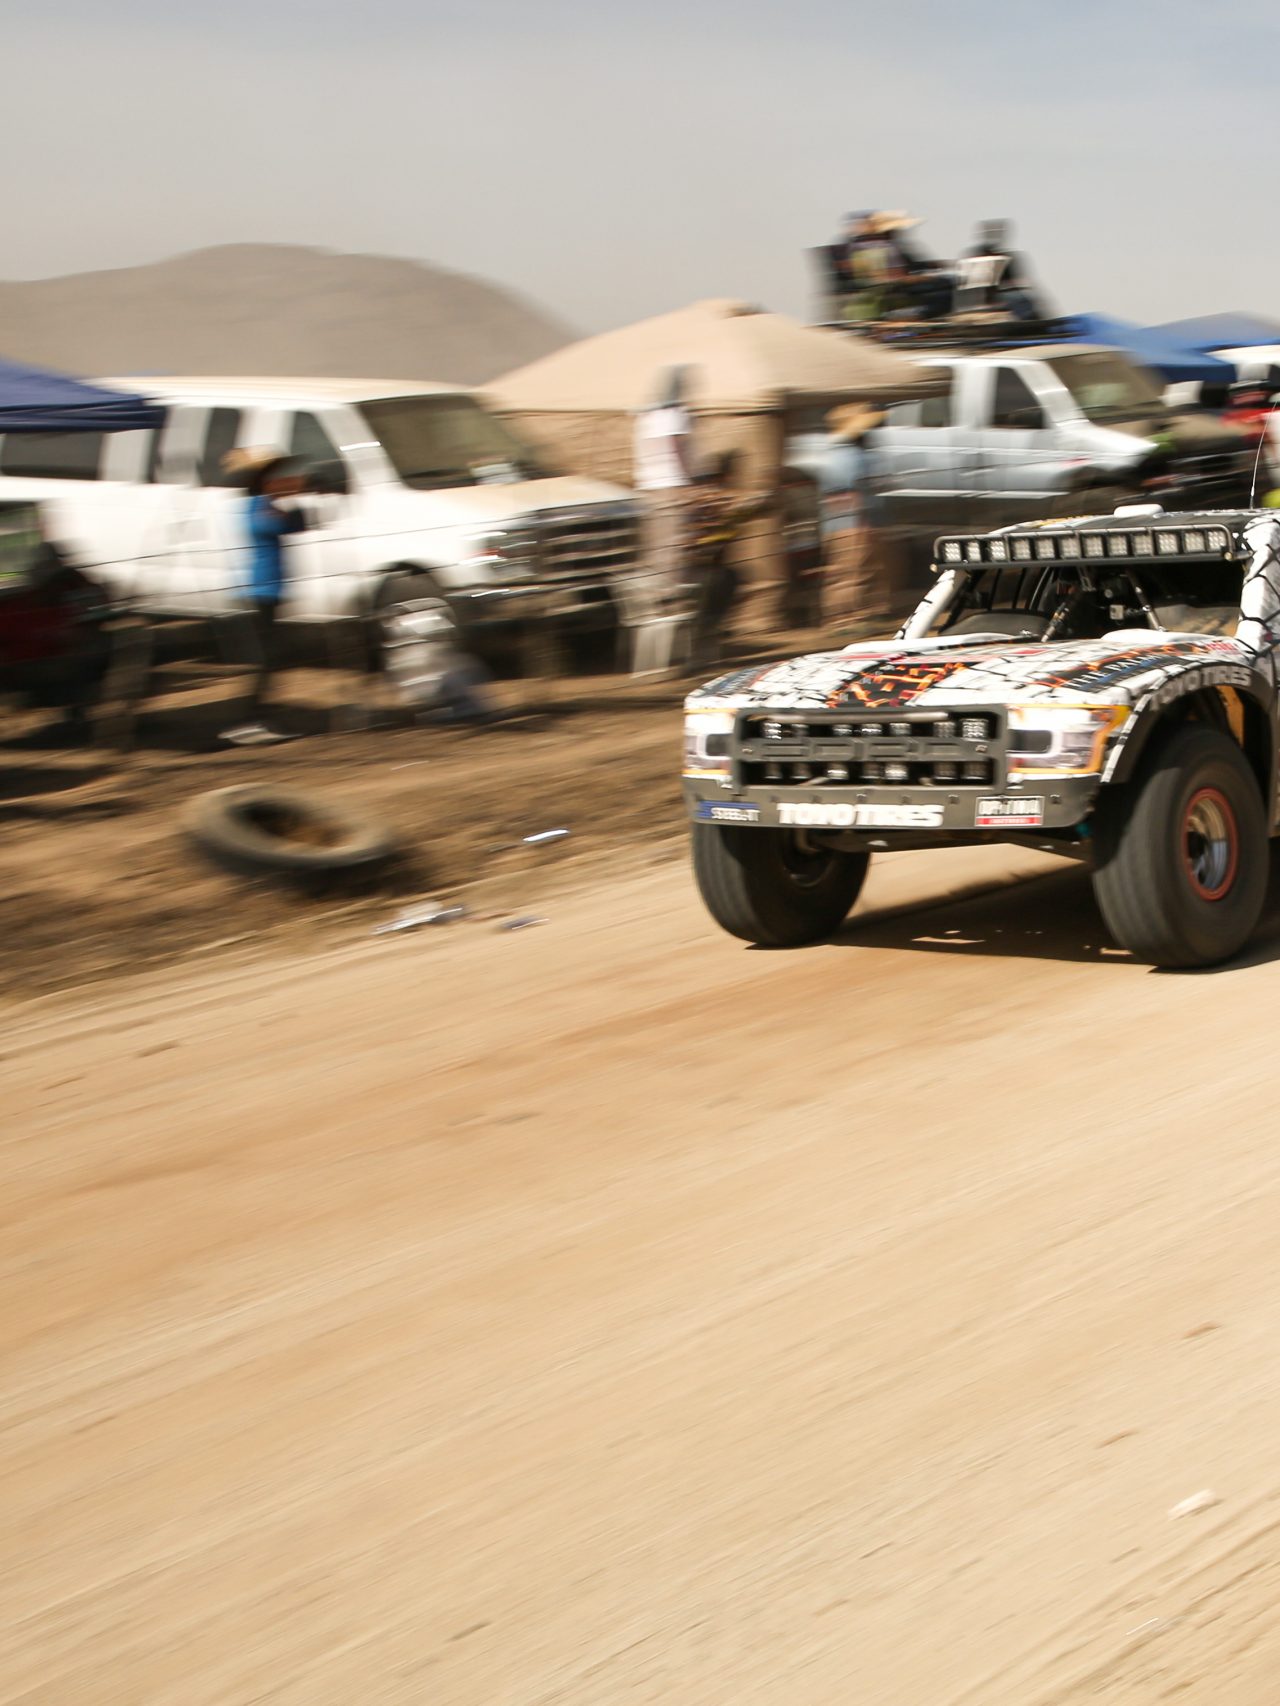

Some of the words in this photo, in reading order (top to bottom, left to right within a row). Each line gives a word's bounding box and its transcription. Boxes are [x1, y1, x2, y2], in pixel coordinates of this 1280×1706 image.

[1149, 670, 1200, 711] TOYO
[1200, 665, 1252, 687] TIRES
[776, 802, 856, 826] TOYO
[855, 803, 945, 828] TIRES
